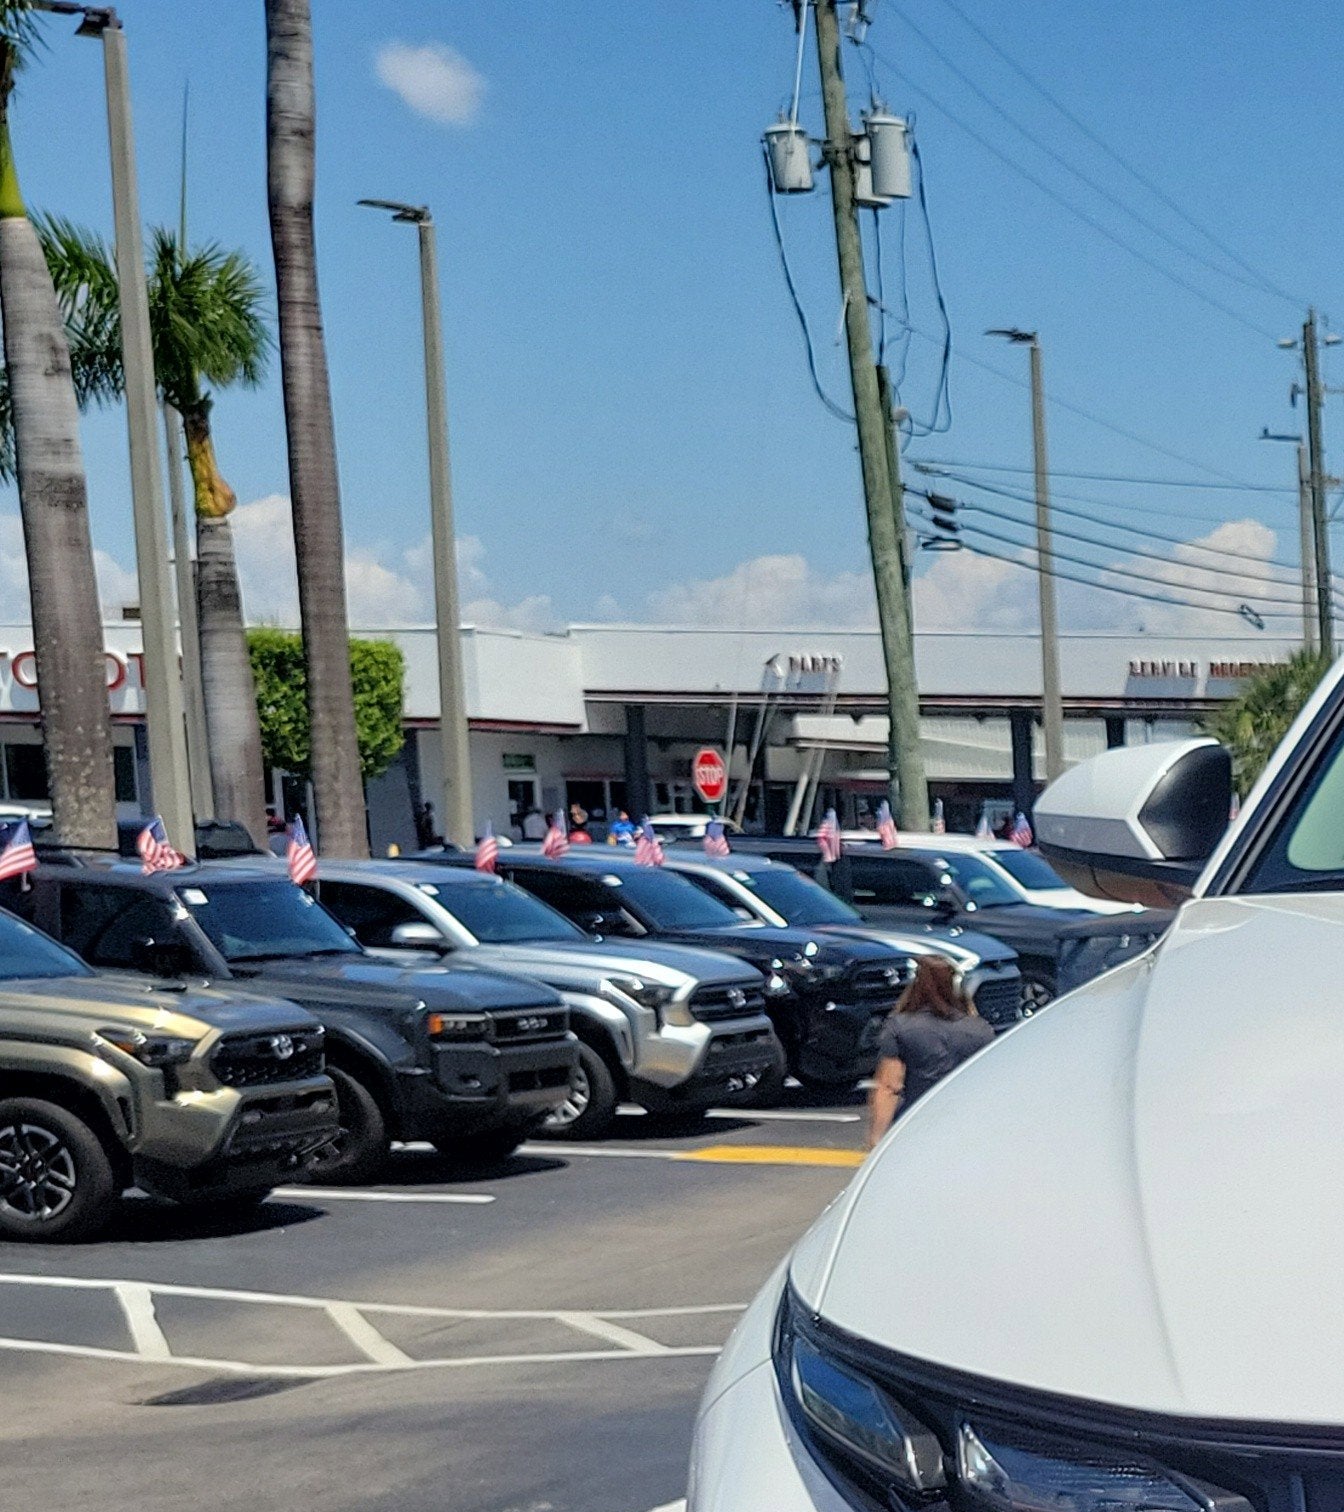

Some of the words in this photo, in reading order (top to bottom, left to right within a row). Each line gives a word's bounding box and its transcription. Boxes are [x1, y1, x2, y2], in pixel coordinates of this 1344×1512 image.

[789, 656, 840, 672] PARTS
[1129, 661, 1197, 678] SERVICE
[697, 766, 723, 785] STOP
